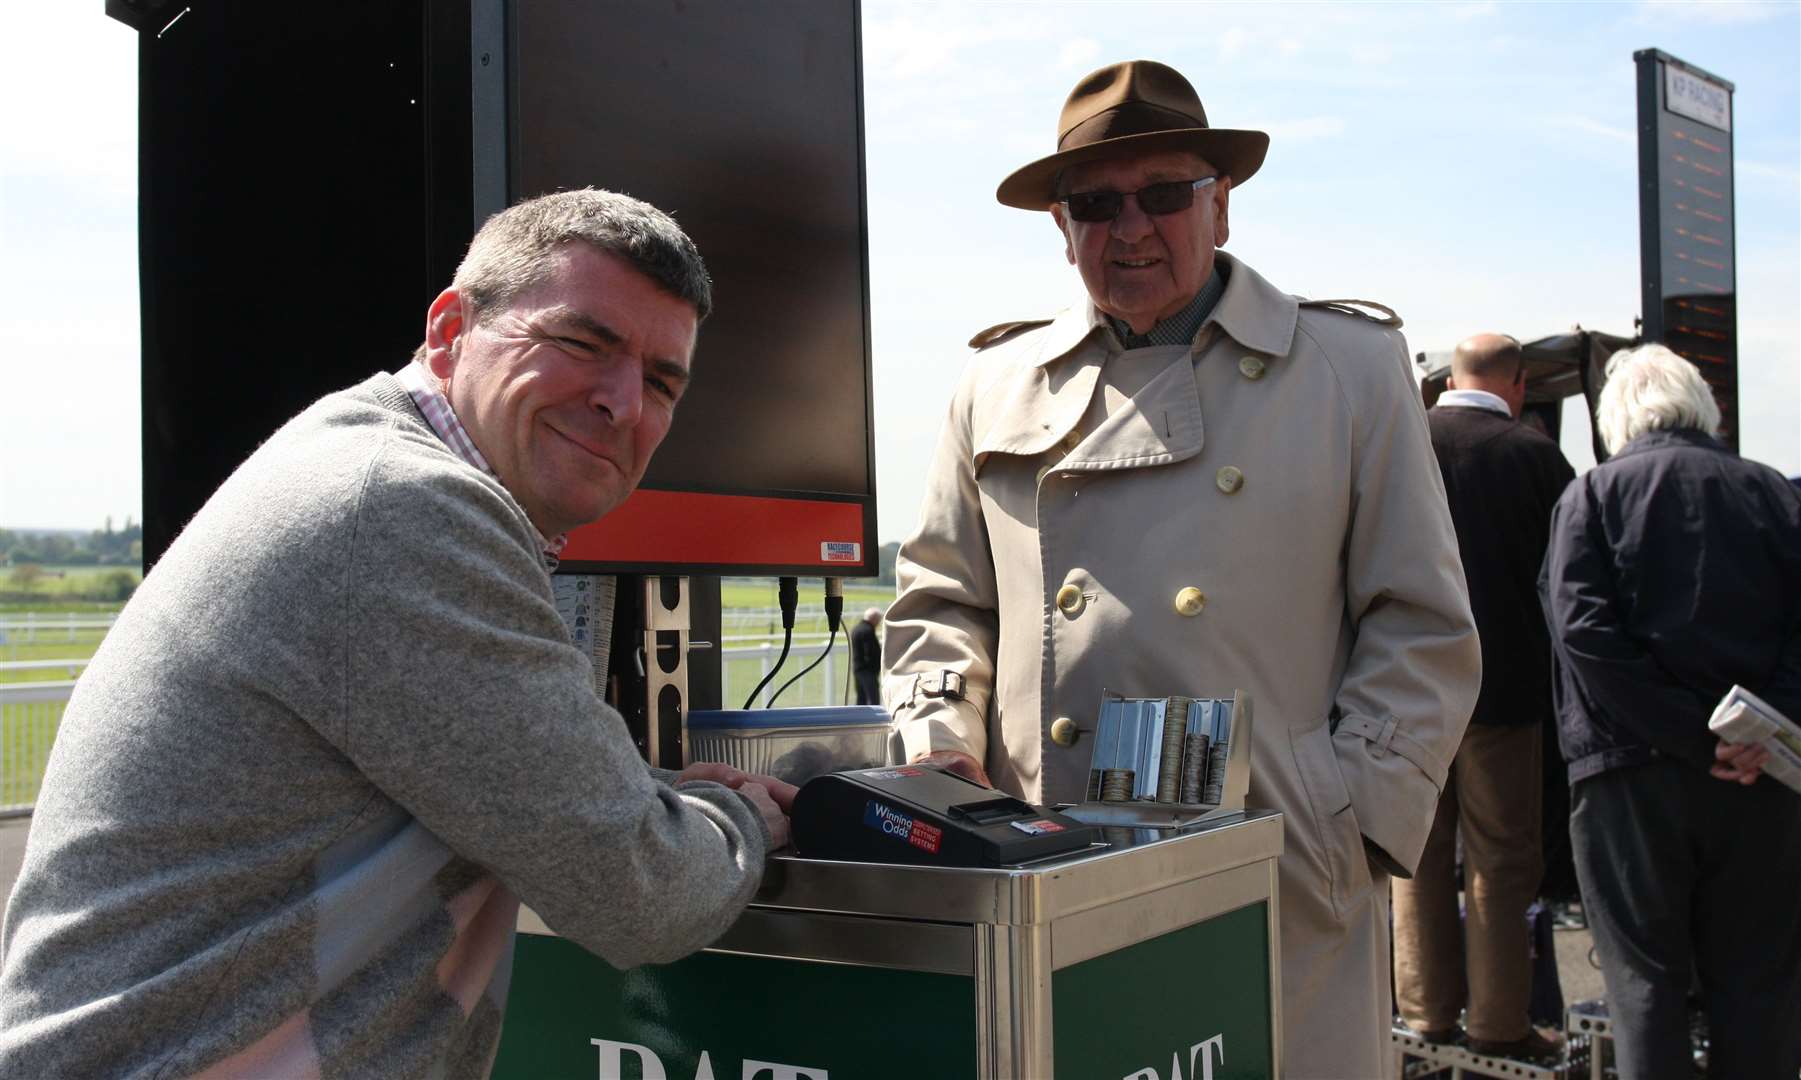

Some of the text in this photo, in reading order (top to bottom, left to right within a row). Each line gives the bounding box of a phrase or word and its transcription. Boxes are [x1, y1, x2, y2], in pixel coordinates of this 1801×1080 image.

[1672, 75, 1724, 113] KP RACING
[875, 803, 912, 830] Winning
[883, 820, 908, 838] Odds
[912, 827, 937, 842] BETTING
[910, 836, 935, 851] SYSTEMS
